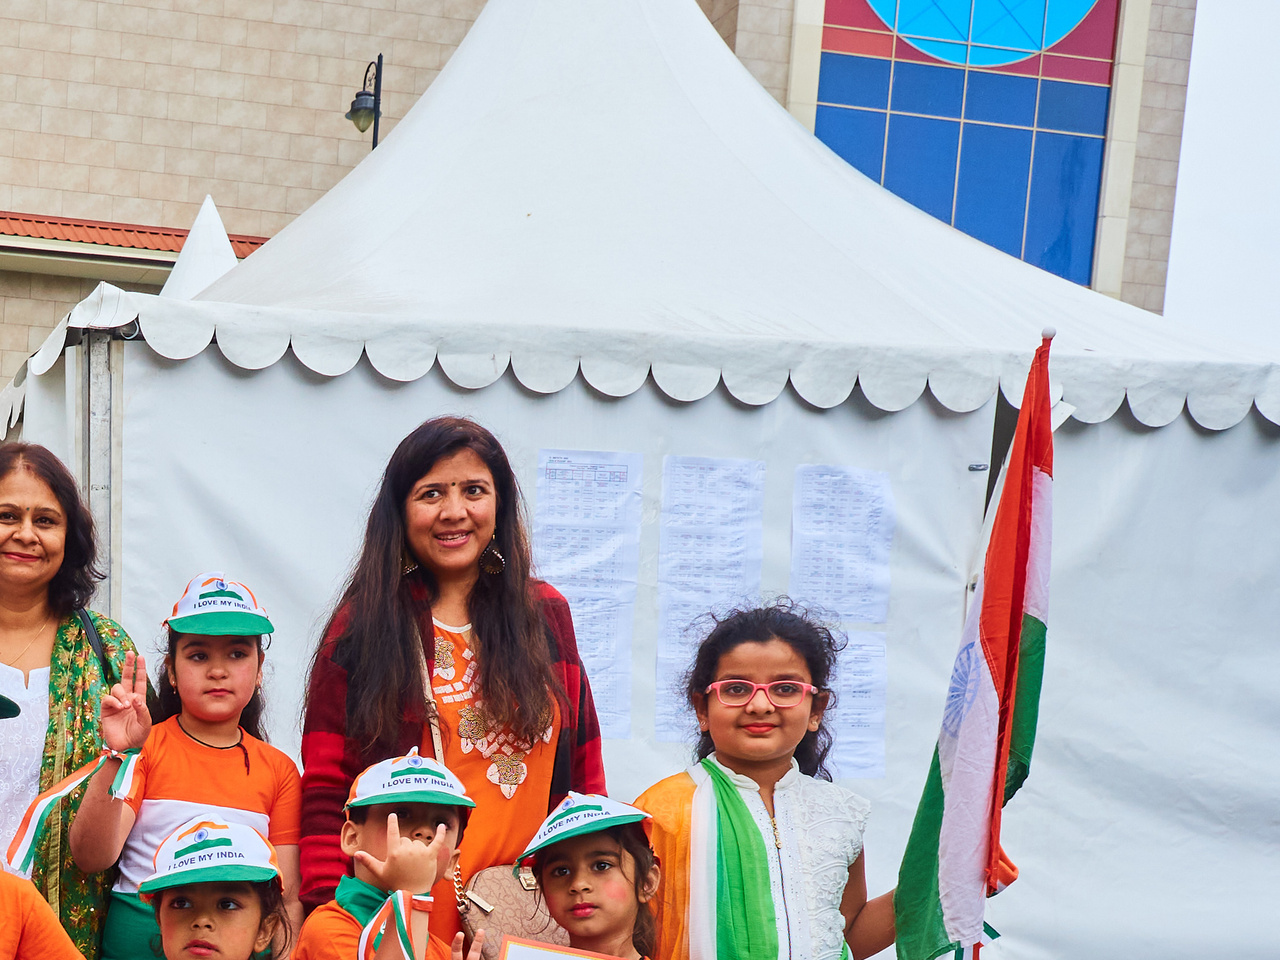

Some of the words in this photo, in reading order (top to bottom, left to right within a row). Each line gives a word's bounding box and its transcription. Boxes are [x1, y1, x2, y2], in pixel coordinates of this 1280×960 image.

[198, 600, 218, 608] LOVE
[234, 602, 252, 611] INDIA
[387, 778, 411, 787] LOVE
[431, 778, 455, 789] INDIA
[543, 820, 564, 836] LOVE
[566, 814, 581, 824] MY
[173, 857, 196, 869] LOVE
[198, 852, 213, 862] MY
[217, 851, 245, 859] INDIA
